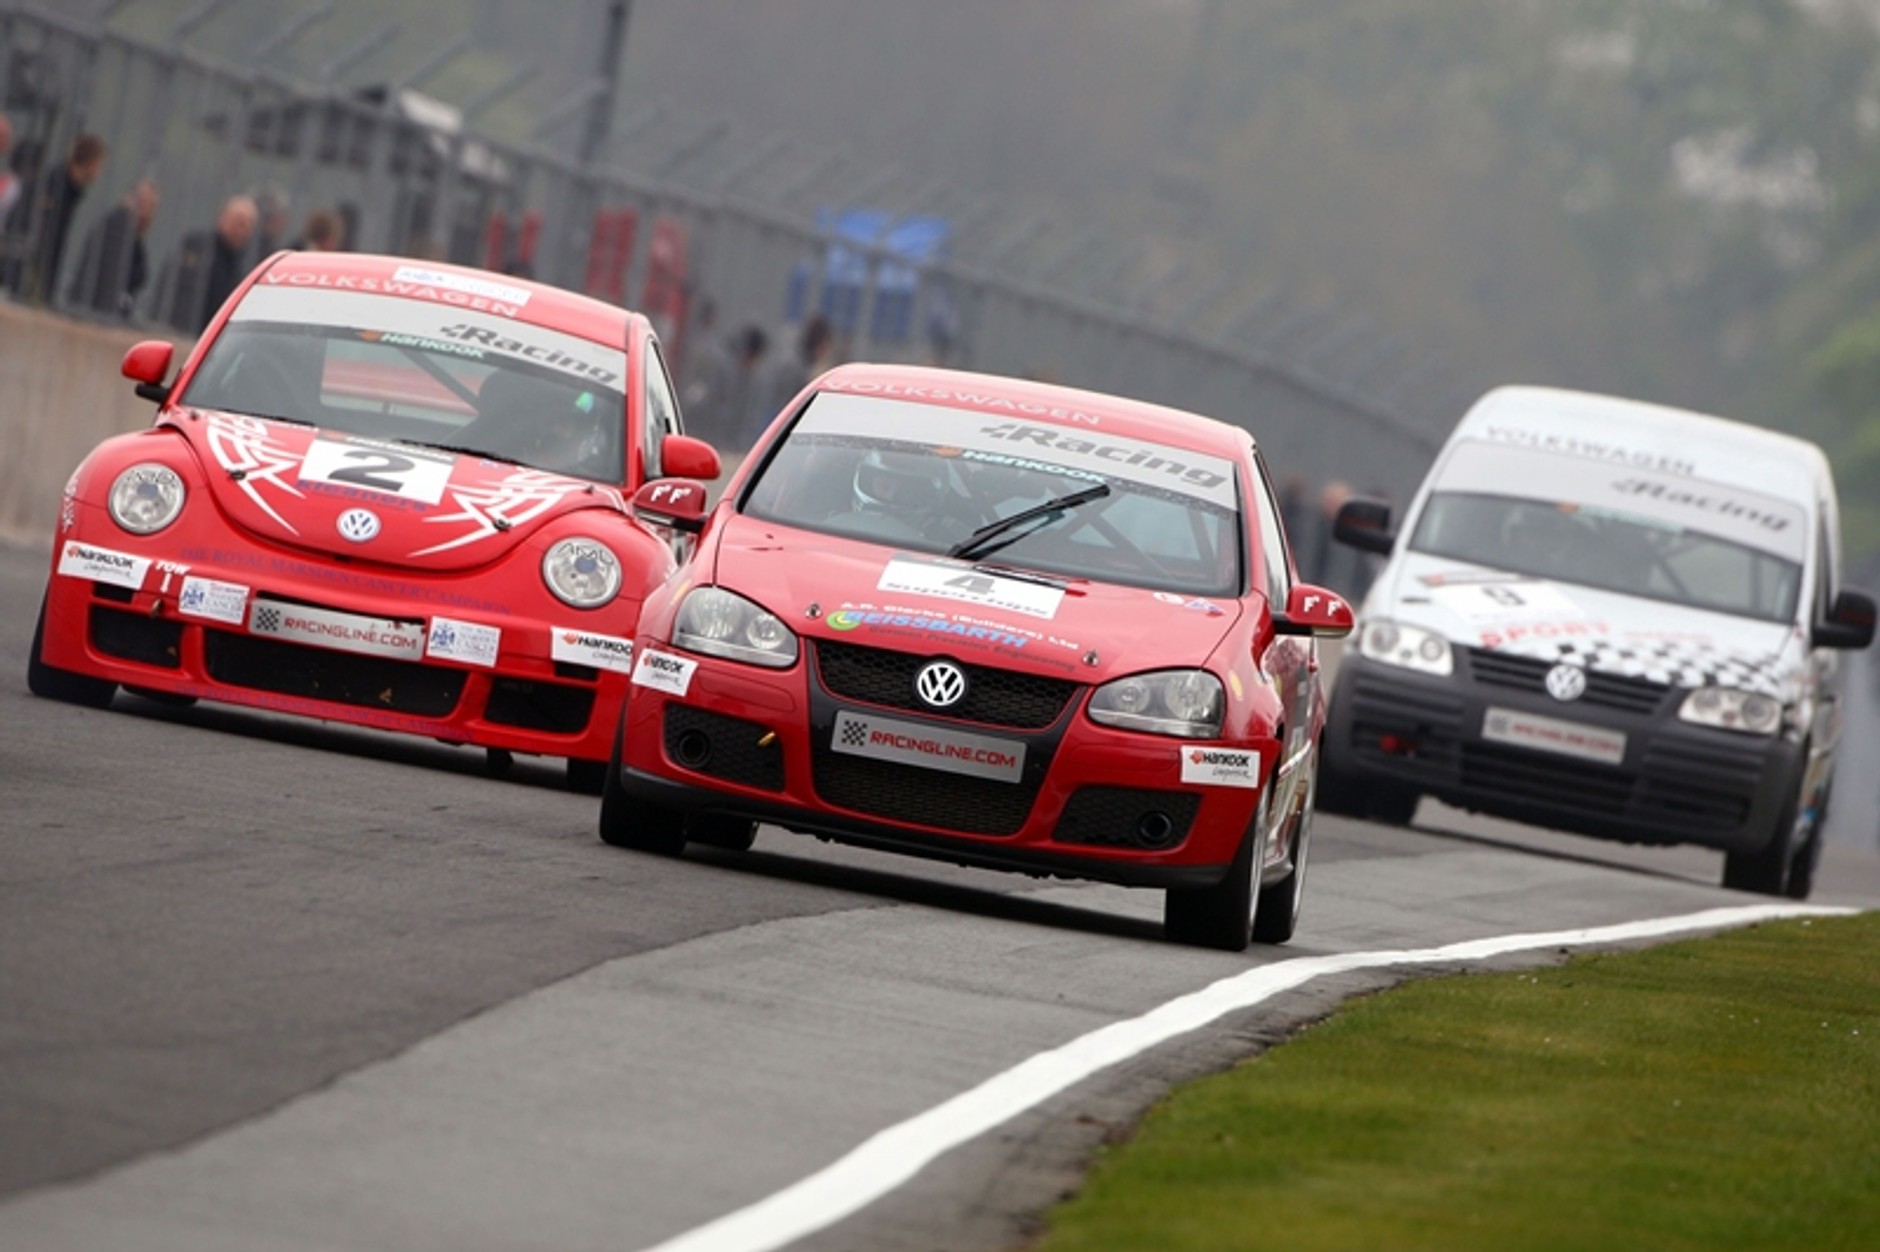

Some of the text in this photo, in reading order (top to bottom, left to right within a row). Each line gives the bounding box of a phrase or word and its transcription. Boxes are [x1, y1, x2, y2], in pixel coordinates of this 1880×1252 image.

[266, 272, 518, 318] VOLKSWAGEN
[459, 326, 618, 384] Racing
[821, 379, 1100, 425] VOLKSWAGEN
[327, 450, 415, 492] 2
[1006, 424, 1228, 490] Racing
[1486, 427, 1697, 476] VOLKSWAGEN
[155, 560, 191, 575] TOW
[943, 574, 996, 595] 4
[283, 616, 418, 650] RACINGLINE.COM
[843, 610, 1030, 649] BEISSBARTH
[869, 729, 1017, 768] RACINGLINE.COM
